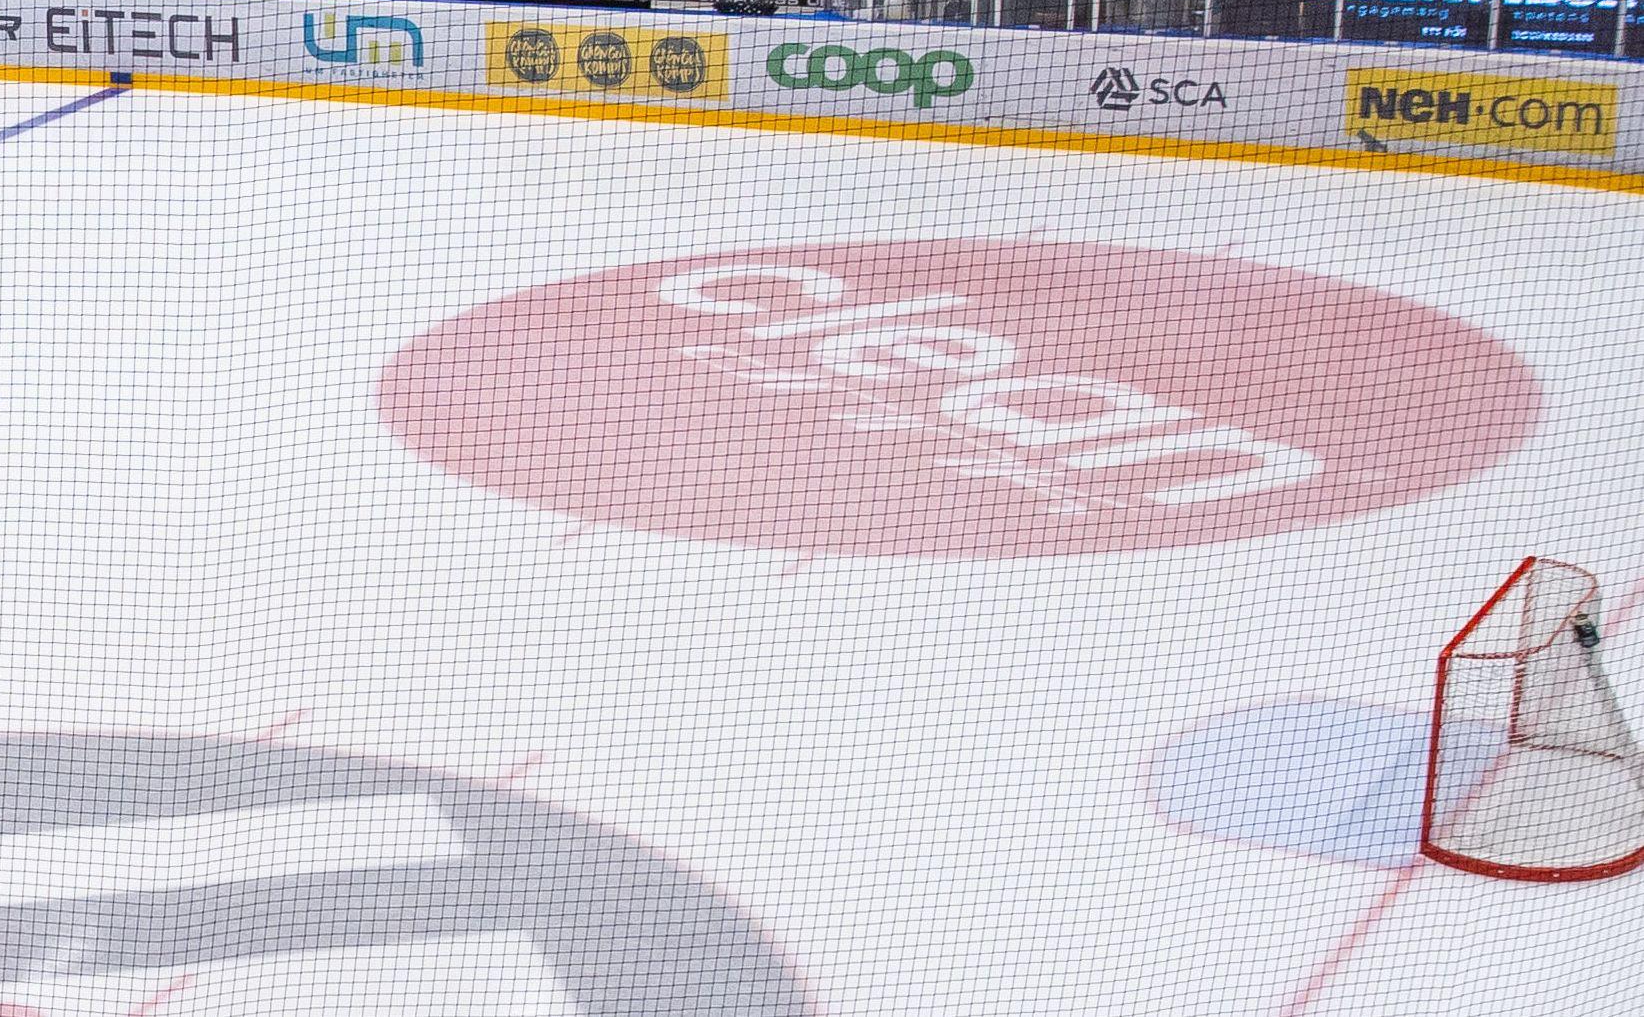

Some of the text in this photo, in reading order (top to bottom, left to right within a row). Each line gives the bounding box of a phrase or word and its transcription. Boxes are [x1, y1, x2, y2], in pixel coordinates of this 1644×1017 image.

[765, 41, 975, 109] coop
[1149, 77, 1229, 111] SCA
[659, 264, 1320, 506] clean
